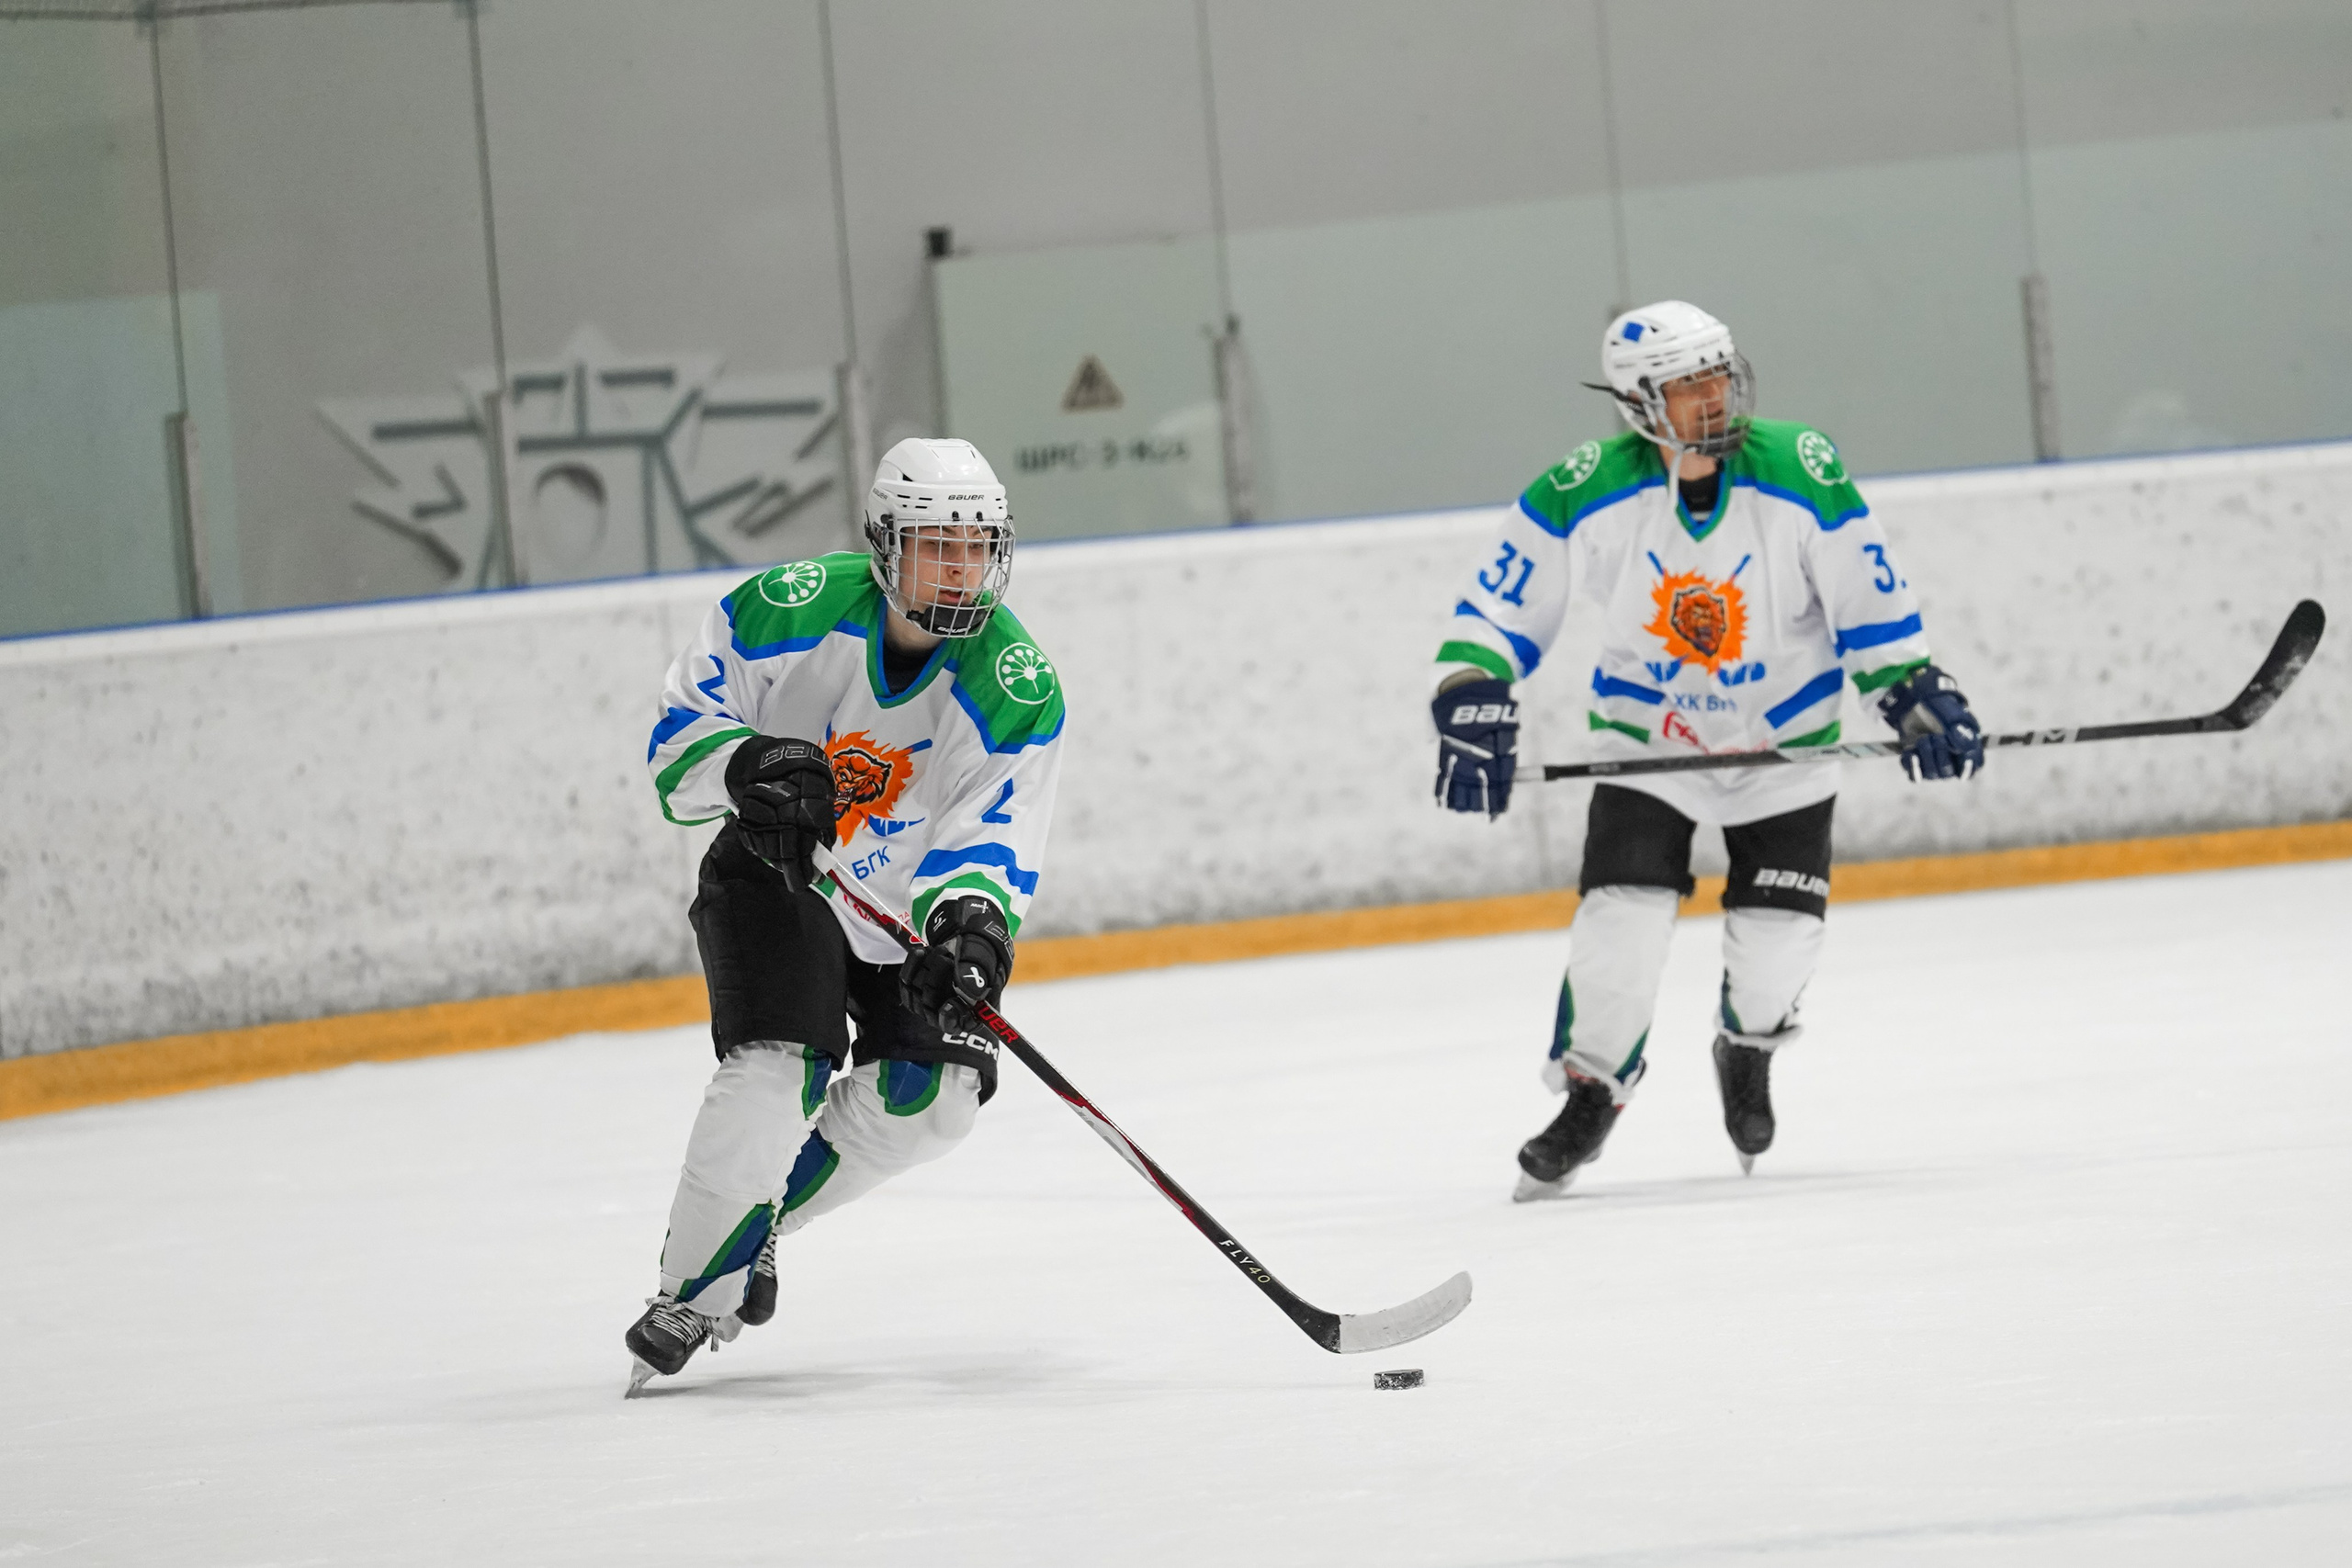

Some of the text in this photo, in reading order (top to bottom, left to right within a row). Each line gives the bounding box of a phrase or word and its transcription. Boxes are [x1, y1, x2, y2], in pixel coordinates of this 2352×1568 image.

[1477, 539, 1535, 607] 31
[1862, 544, 1906, 593] 3
[1451, 704, 1518, 725] BAU
[851, 845, 891, 880] БГК
[978, 1005, 1019, 1043] UER
[942, 1032, 1000, 1061] CCM
